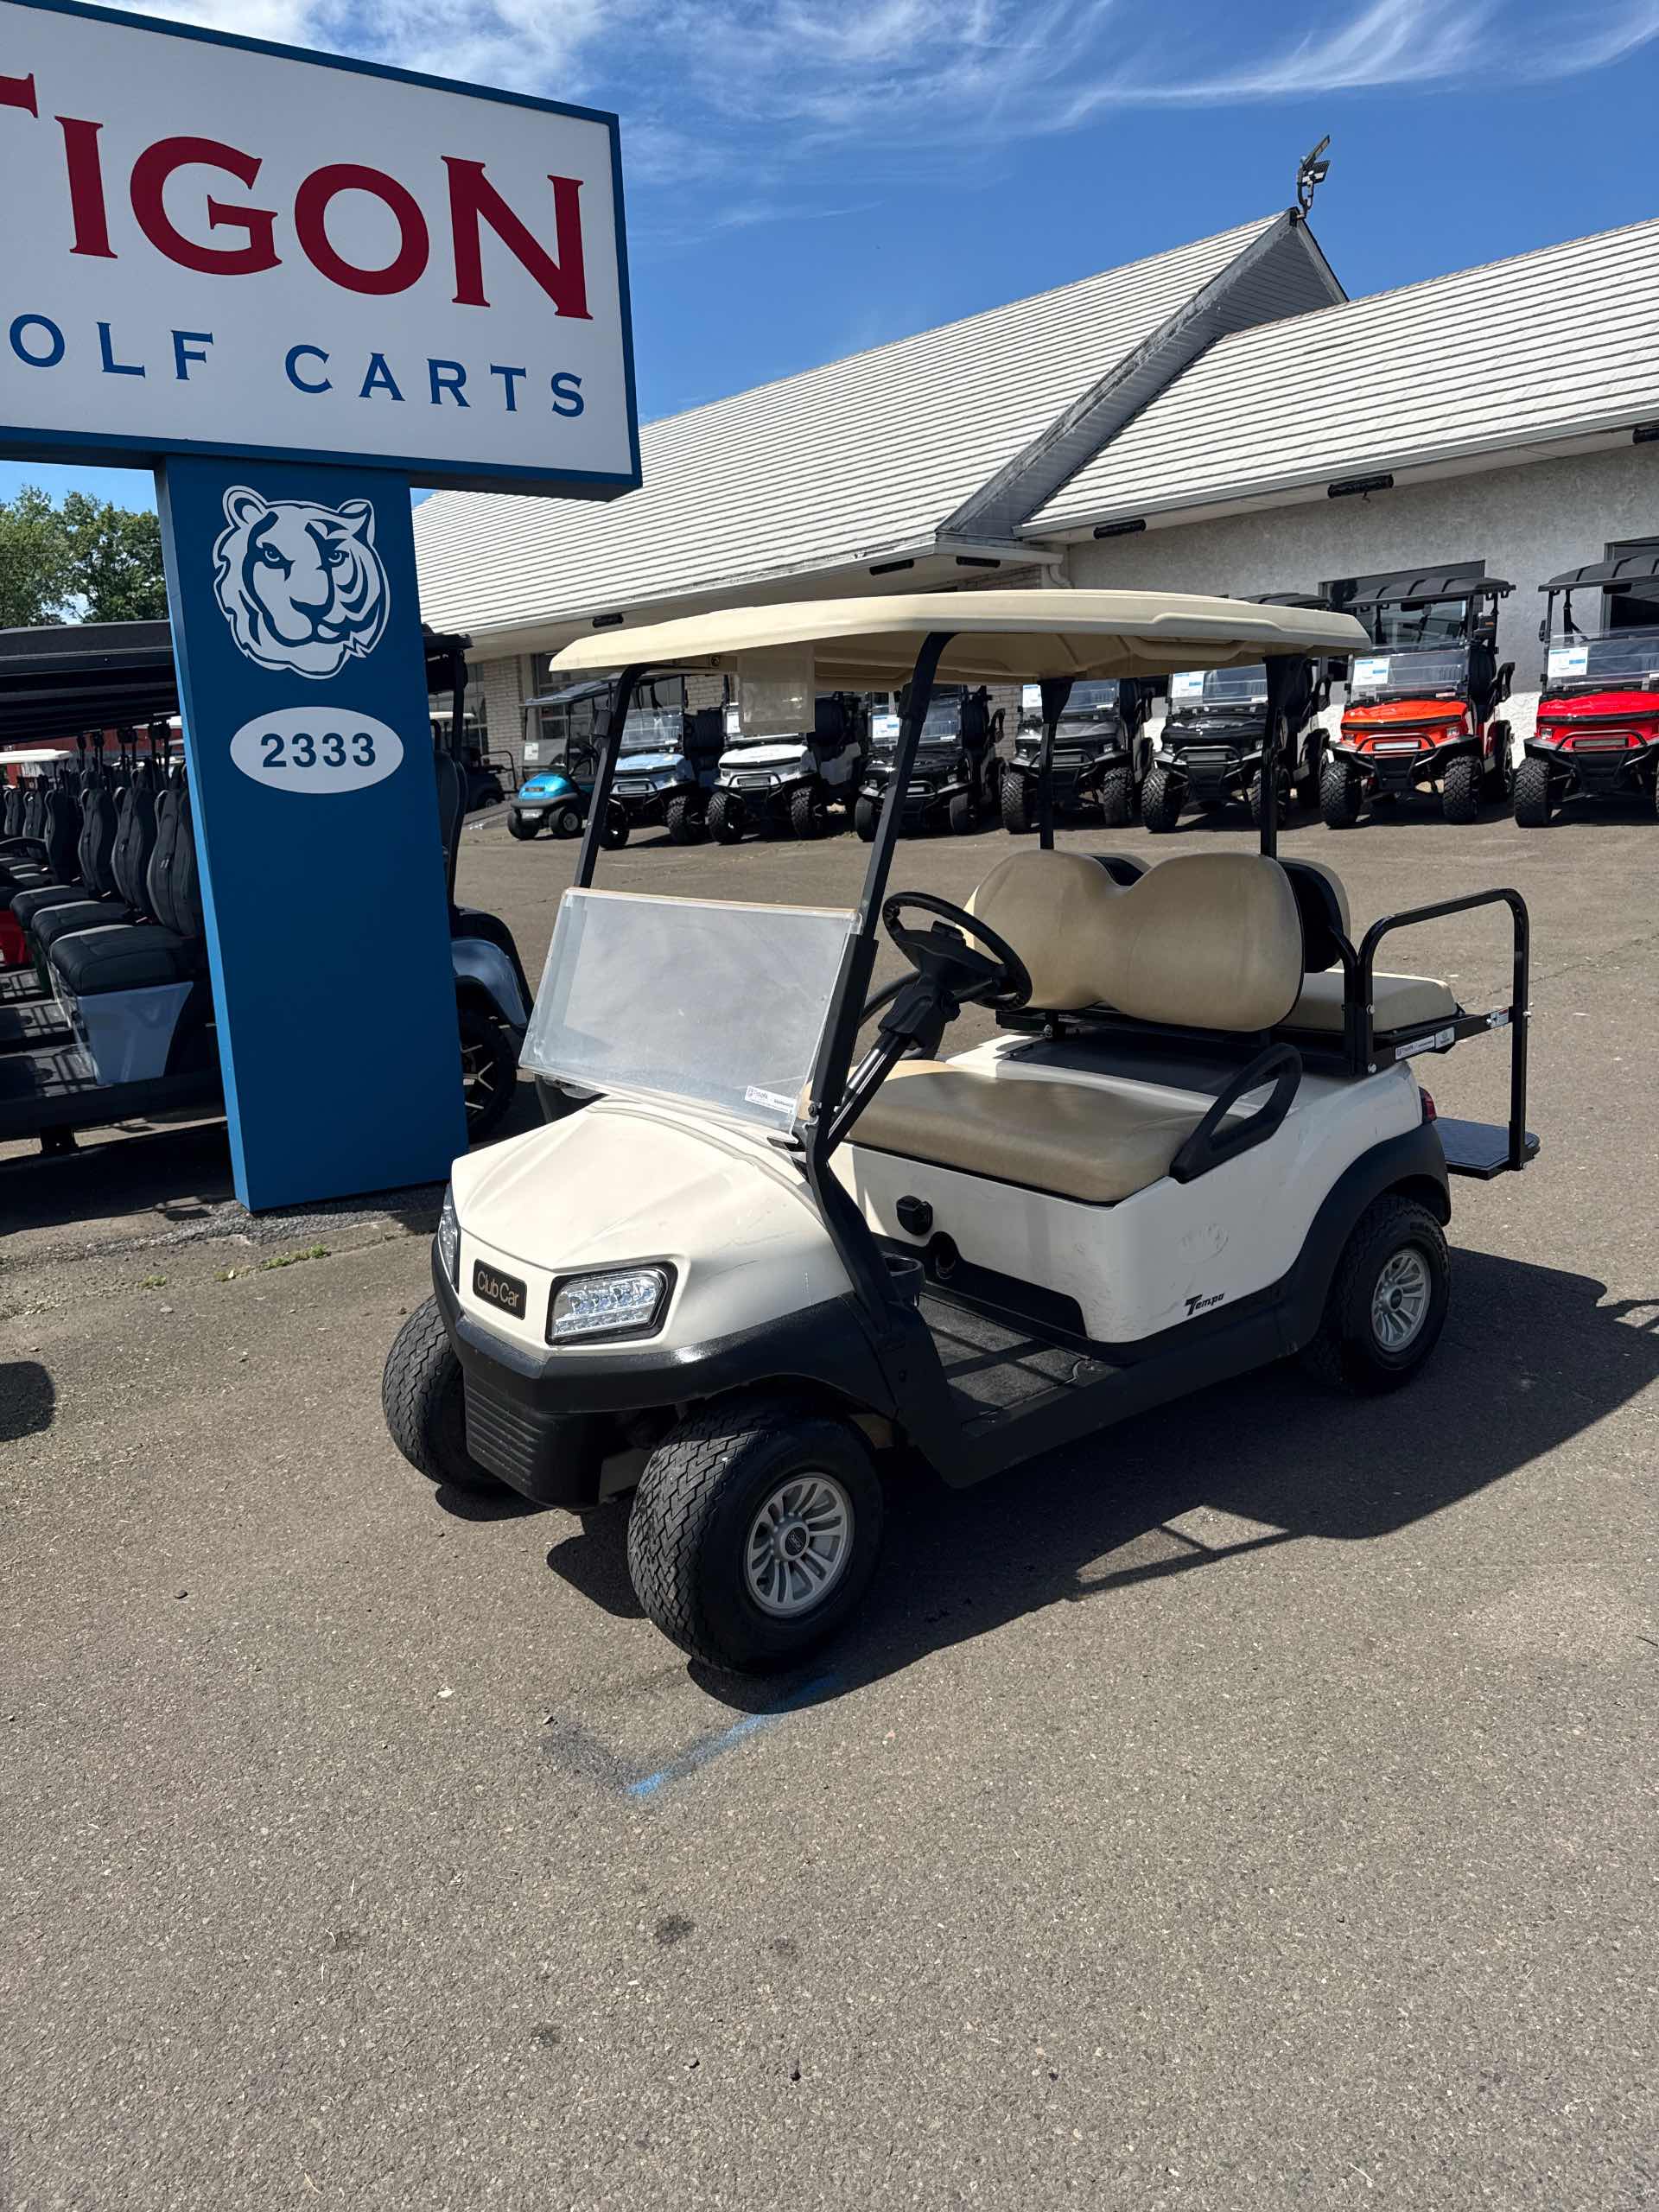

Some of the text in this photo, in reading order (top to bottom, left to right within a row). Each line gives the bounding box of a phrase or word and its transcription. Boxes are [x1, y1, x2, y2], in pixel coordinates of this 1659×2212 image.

[285, 345, 585, 418] CARTS
[261, 733, 376, 767] 2333
[477, 1270, 519, 1306] Club Car
[1184, 1294, 1225, 1316] Tempo
